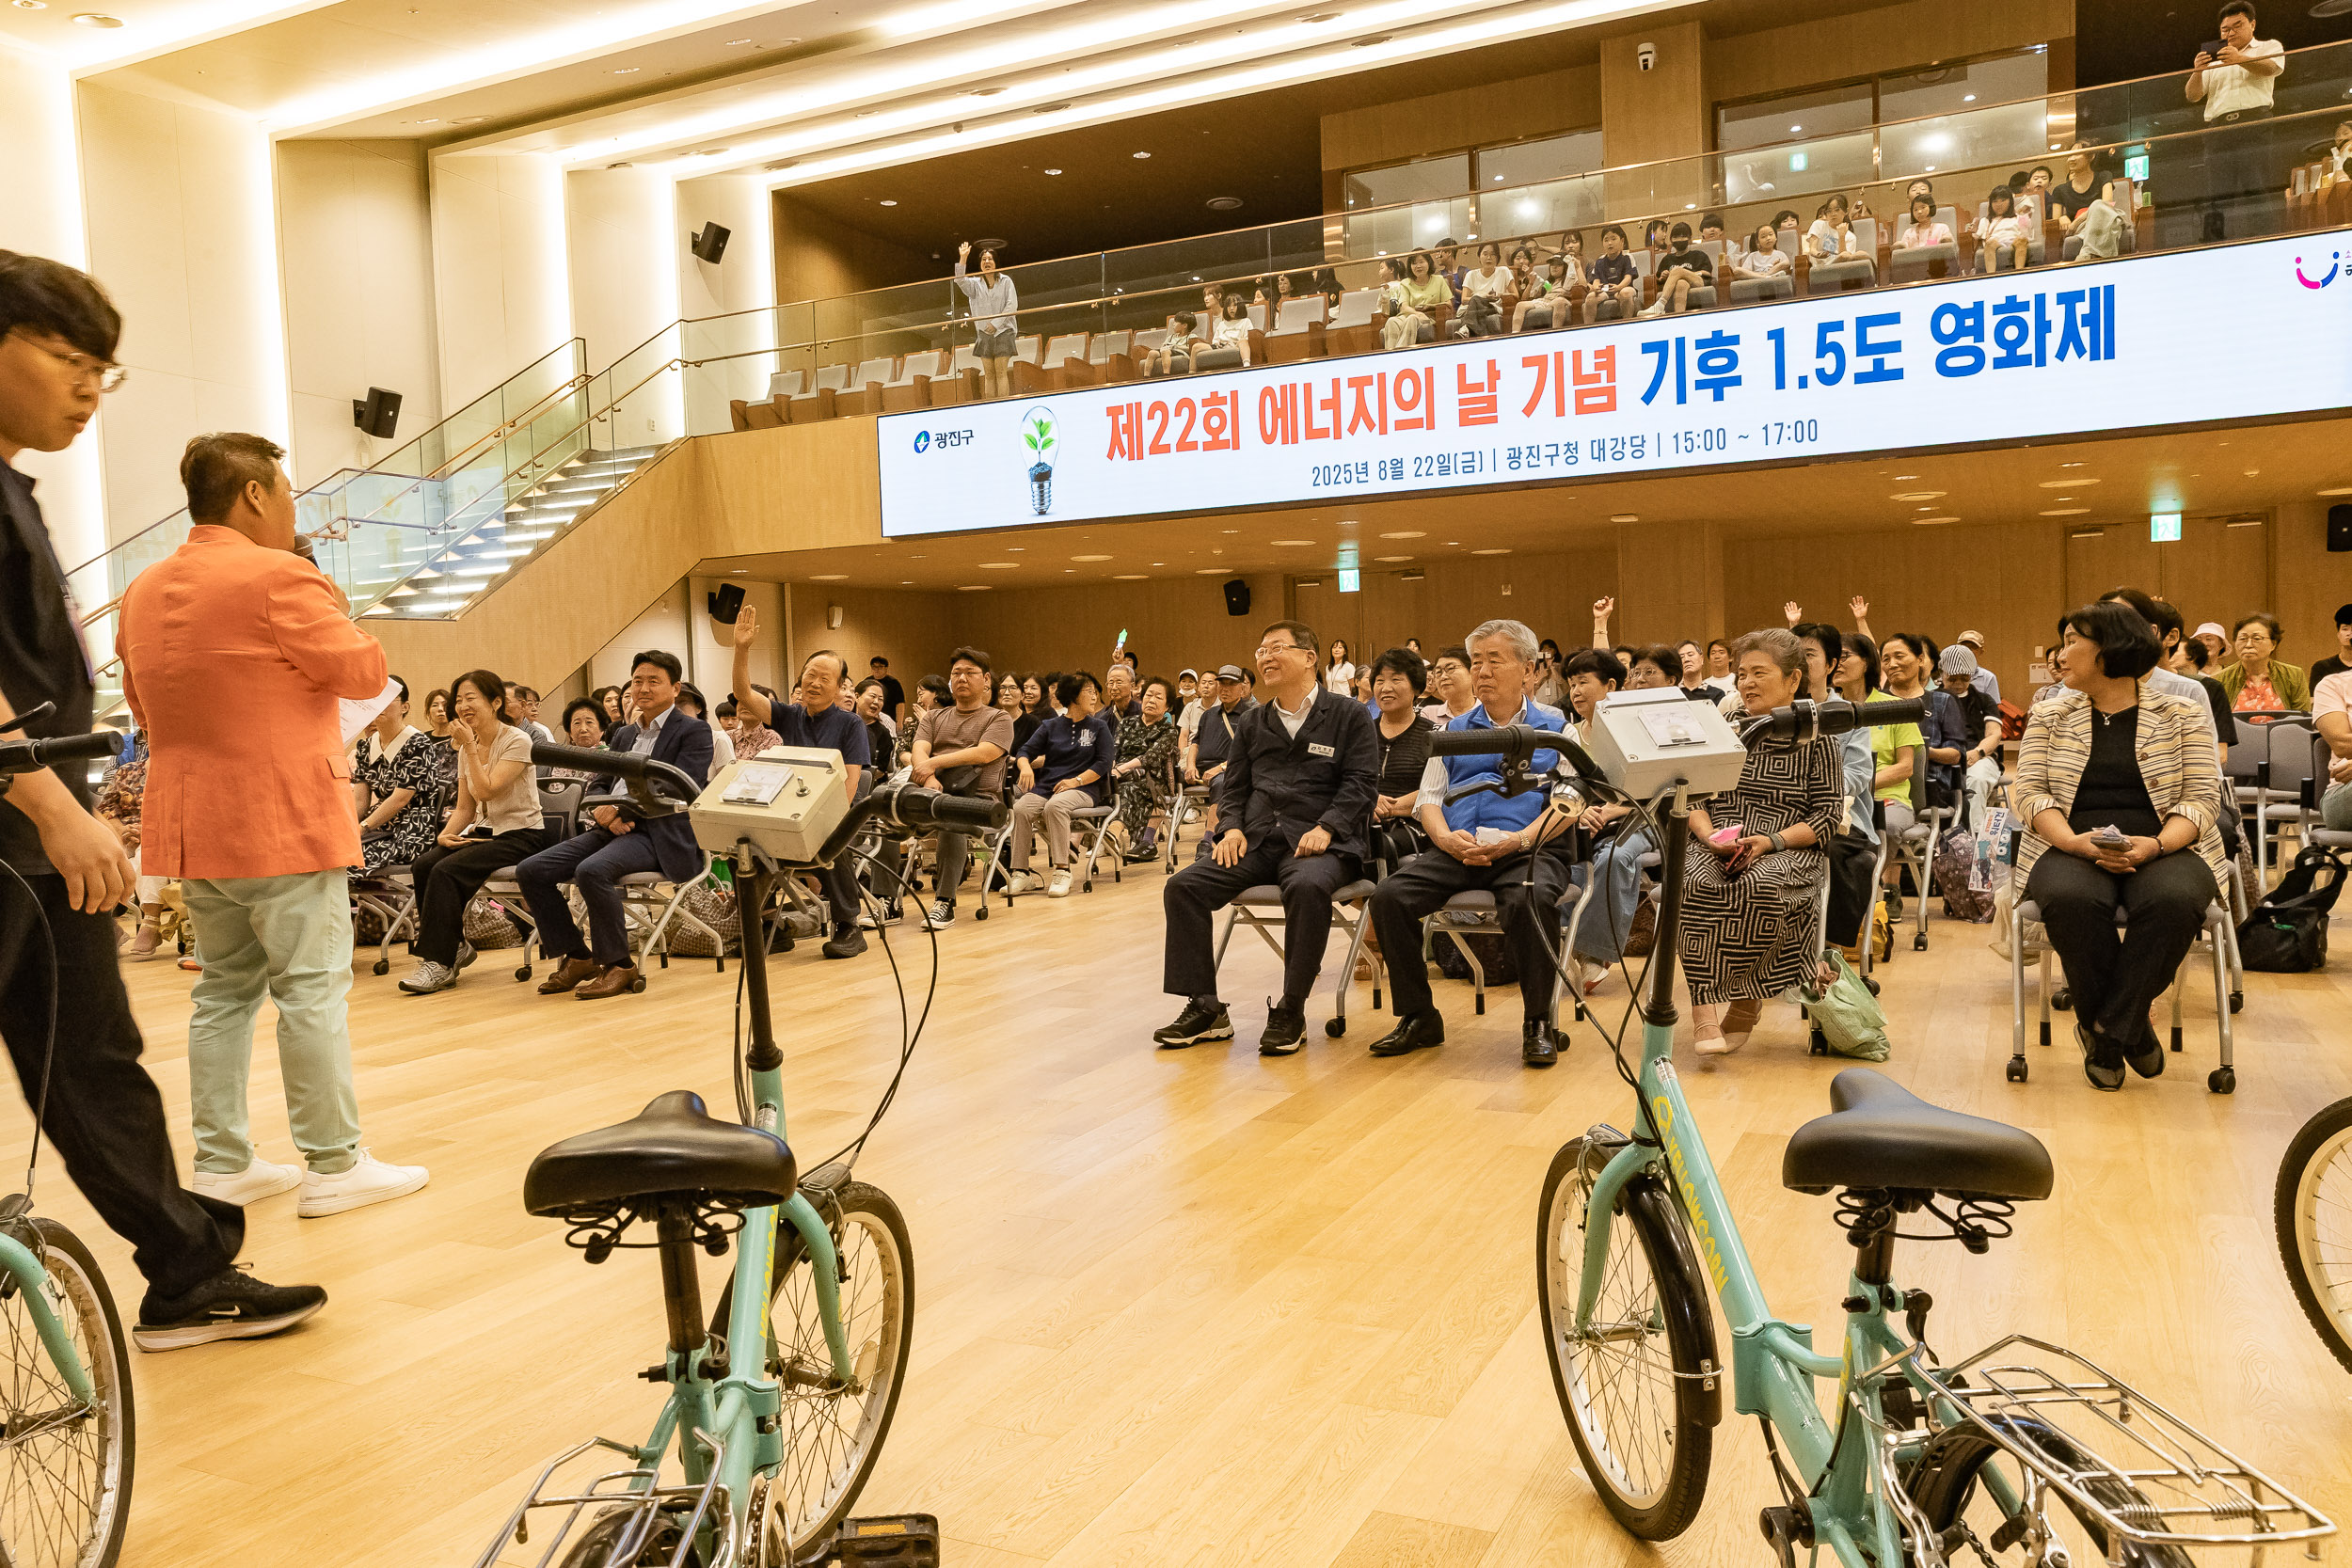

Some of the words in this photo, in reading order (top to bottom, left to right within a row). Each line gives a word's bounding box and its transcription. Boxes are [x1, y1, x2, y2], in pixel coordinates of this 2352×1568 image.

[1105, 389, 1241, 462] 제22회
[1258, 366, 1436, 445] 에너지의
[1456, 358, 1502, 427] 날
[1521, 344, 1617, 418] 기념
[1640, 329, 1742, 406] 기후
[1767, 310, 1905, 390] 1.5도
[1929, 283, 2117, 378] 영화제
[934, 429, 975, 450] 광진구
[1311, 460, 1369, 487] 2025년
[1378, 457, 1405, 482] 8월
[1413, 451, 1484, 478] 22일(금)
[1506, 440, 1580, 471] 광진구청
[1590, 434, 1646, 463] 대강당
[1672, 427, 1727, 454] 15:00
[1761, 419, 1819, 447] 17:00
[1989, 811, 2005, 835] 워터건
[1668, 1136, 1729, 1296] YELLOWCORN
